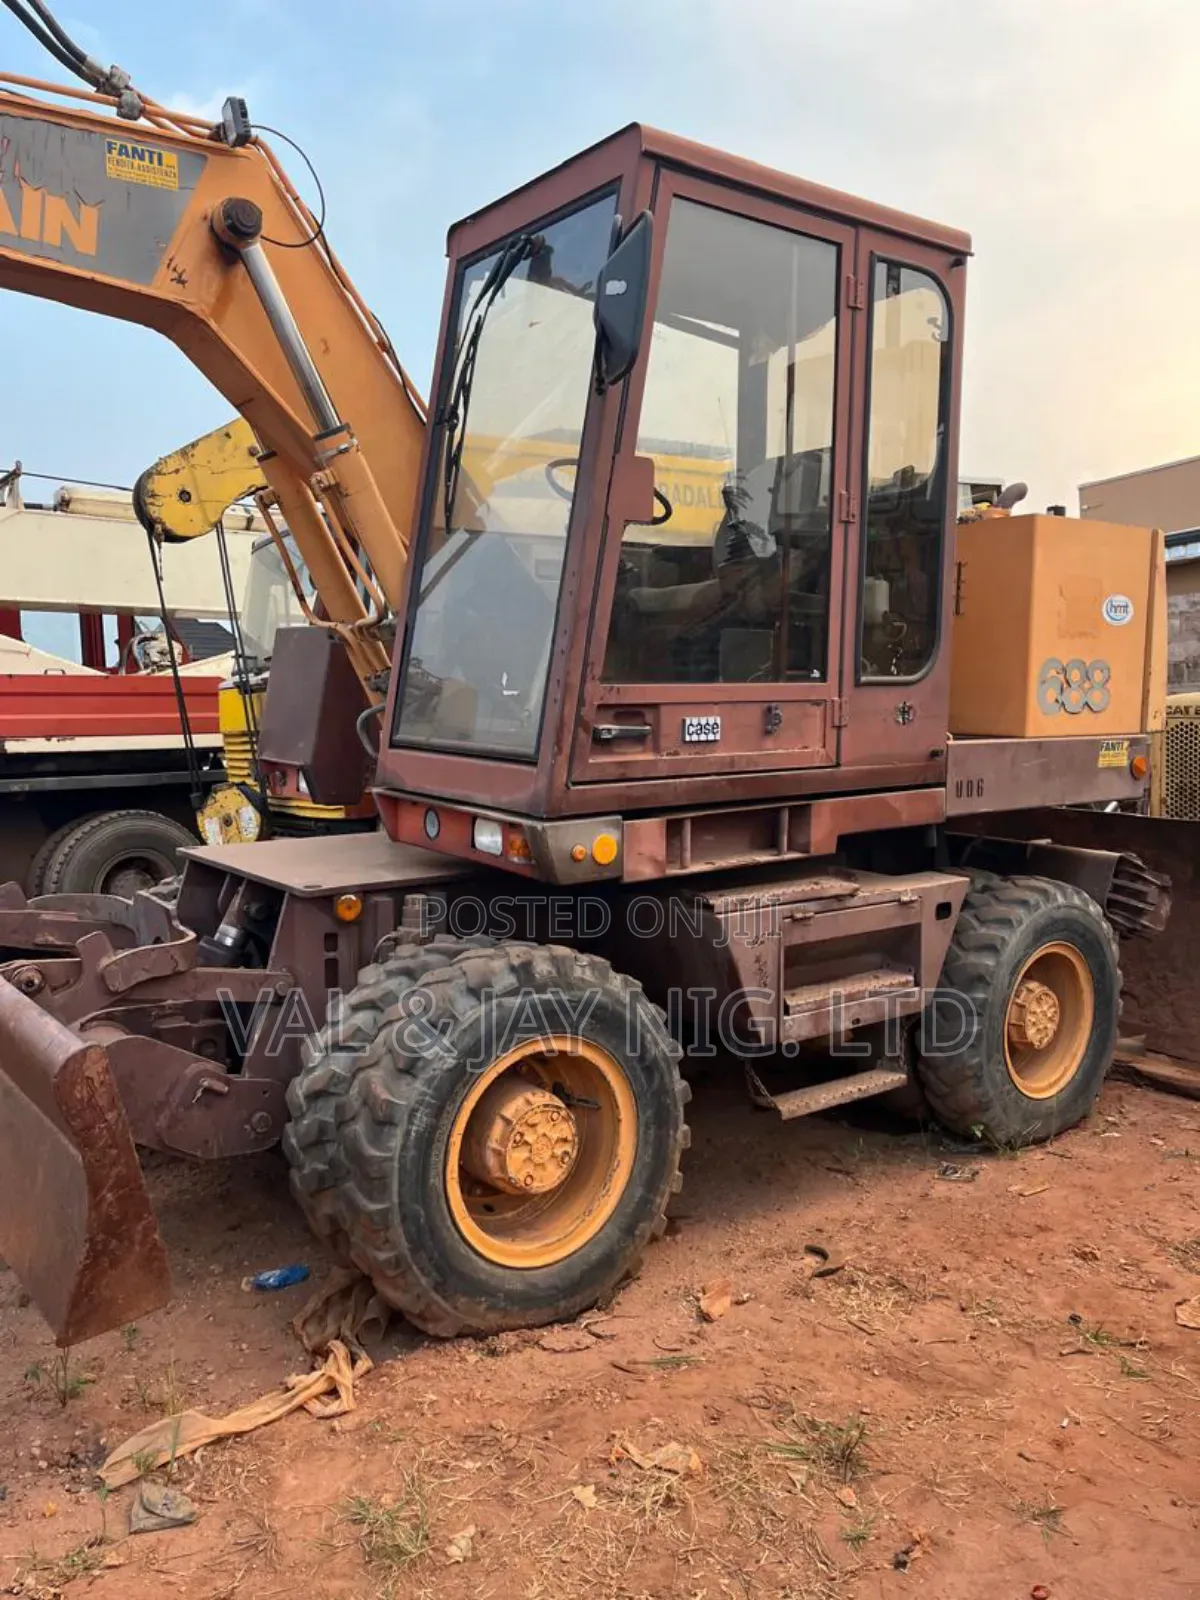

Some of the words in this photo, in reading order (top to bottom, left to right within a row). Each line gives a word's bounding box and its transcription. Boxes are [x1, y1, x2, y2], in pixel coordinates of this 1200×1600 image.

[106, 141, 163, 167] FANTI
[1037, 657, 1111, 716] 688
[686, 719, 720, 738] case
